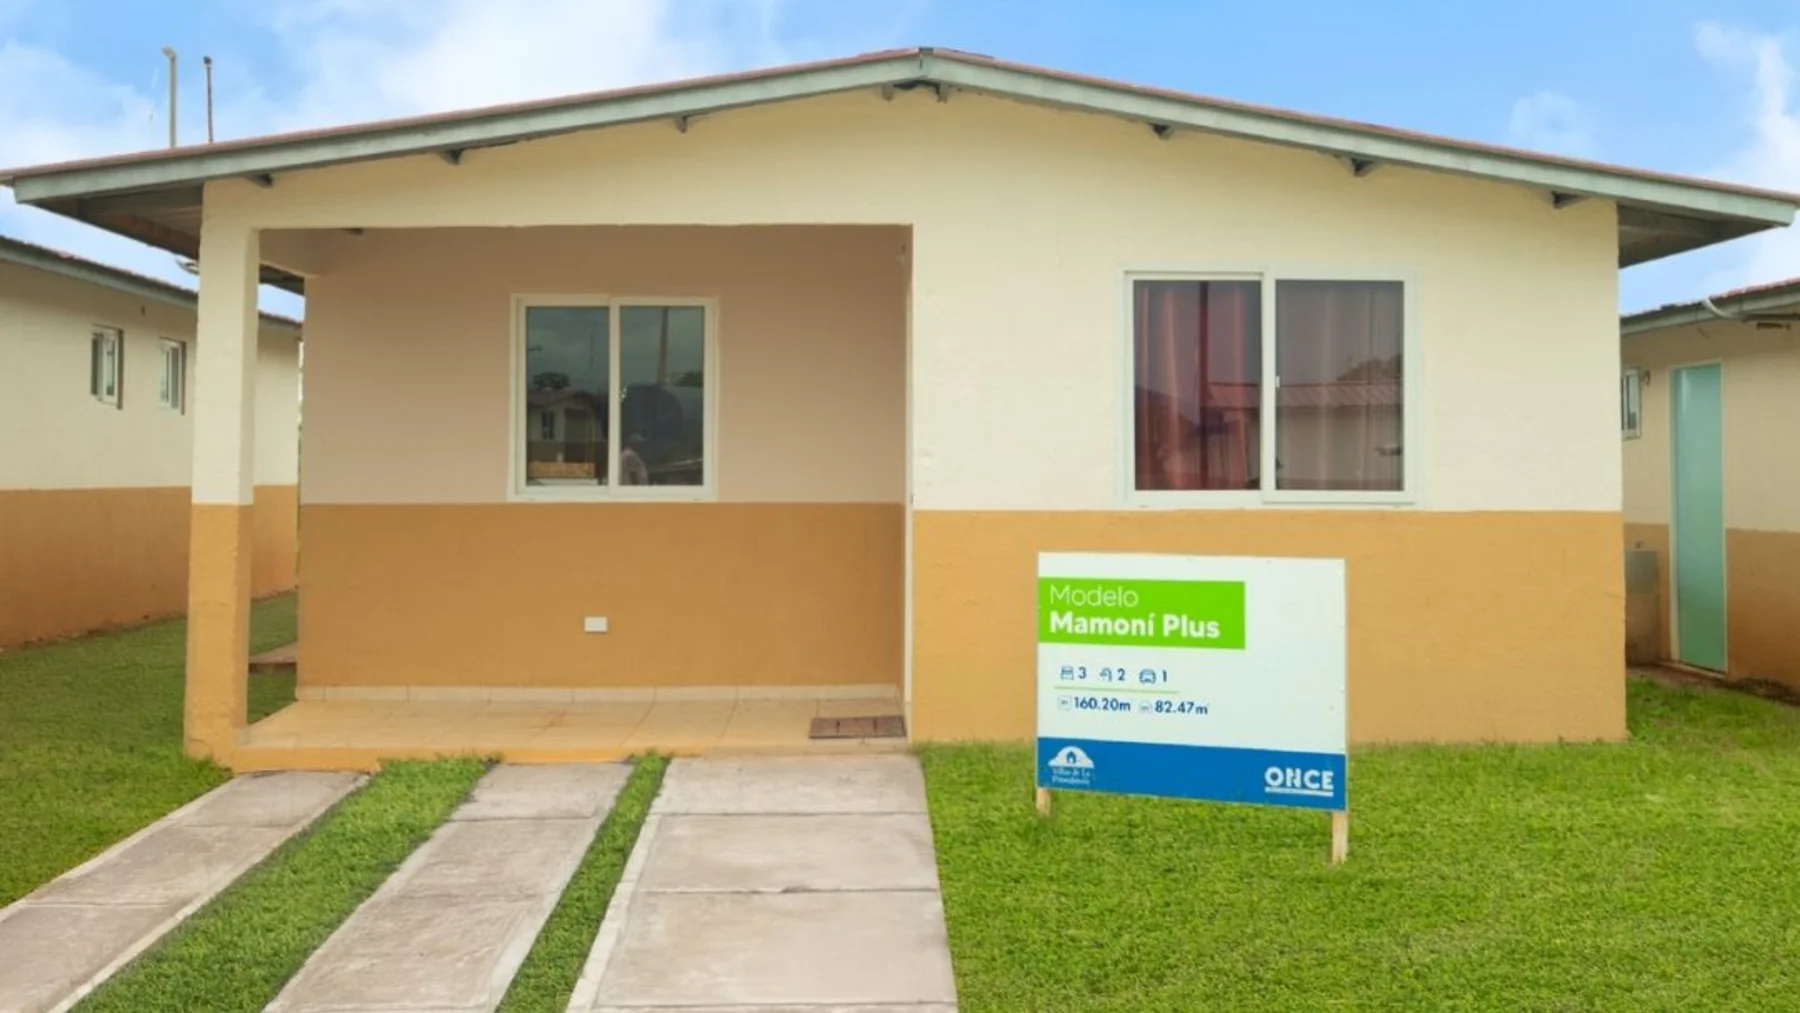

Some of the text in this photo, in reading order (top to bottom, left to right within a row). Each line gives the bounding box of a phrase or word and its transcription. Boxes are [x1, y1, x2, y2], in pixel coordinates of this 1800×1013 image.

[1050, 584, 1139, 607] Modelo
[1050, 611, 1220, 639] Mamoní Plus
[1078, 666, 1167, 682] 3 2 1
[1264, 766, 1334, 790] ONCE
